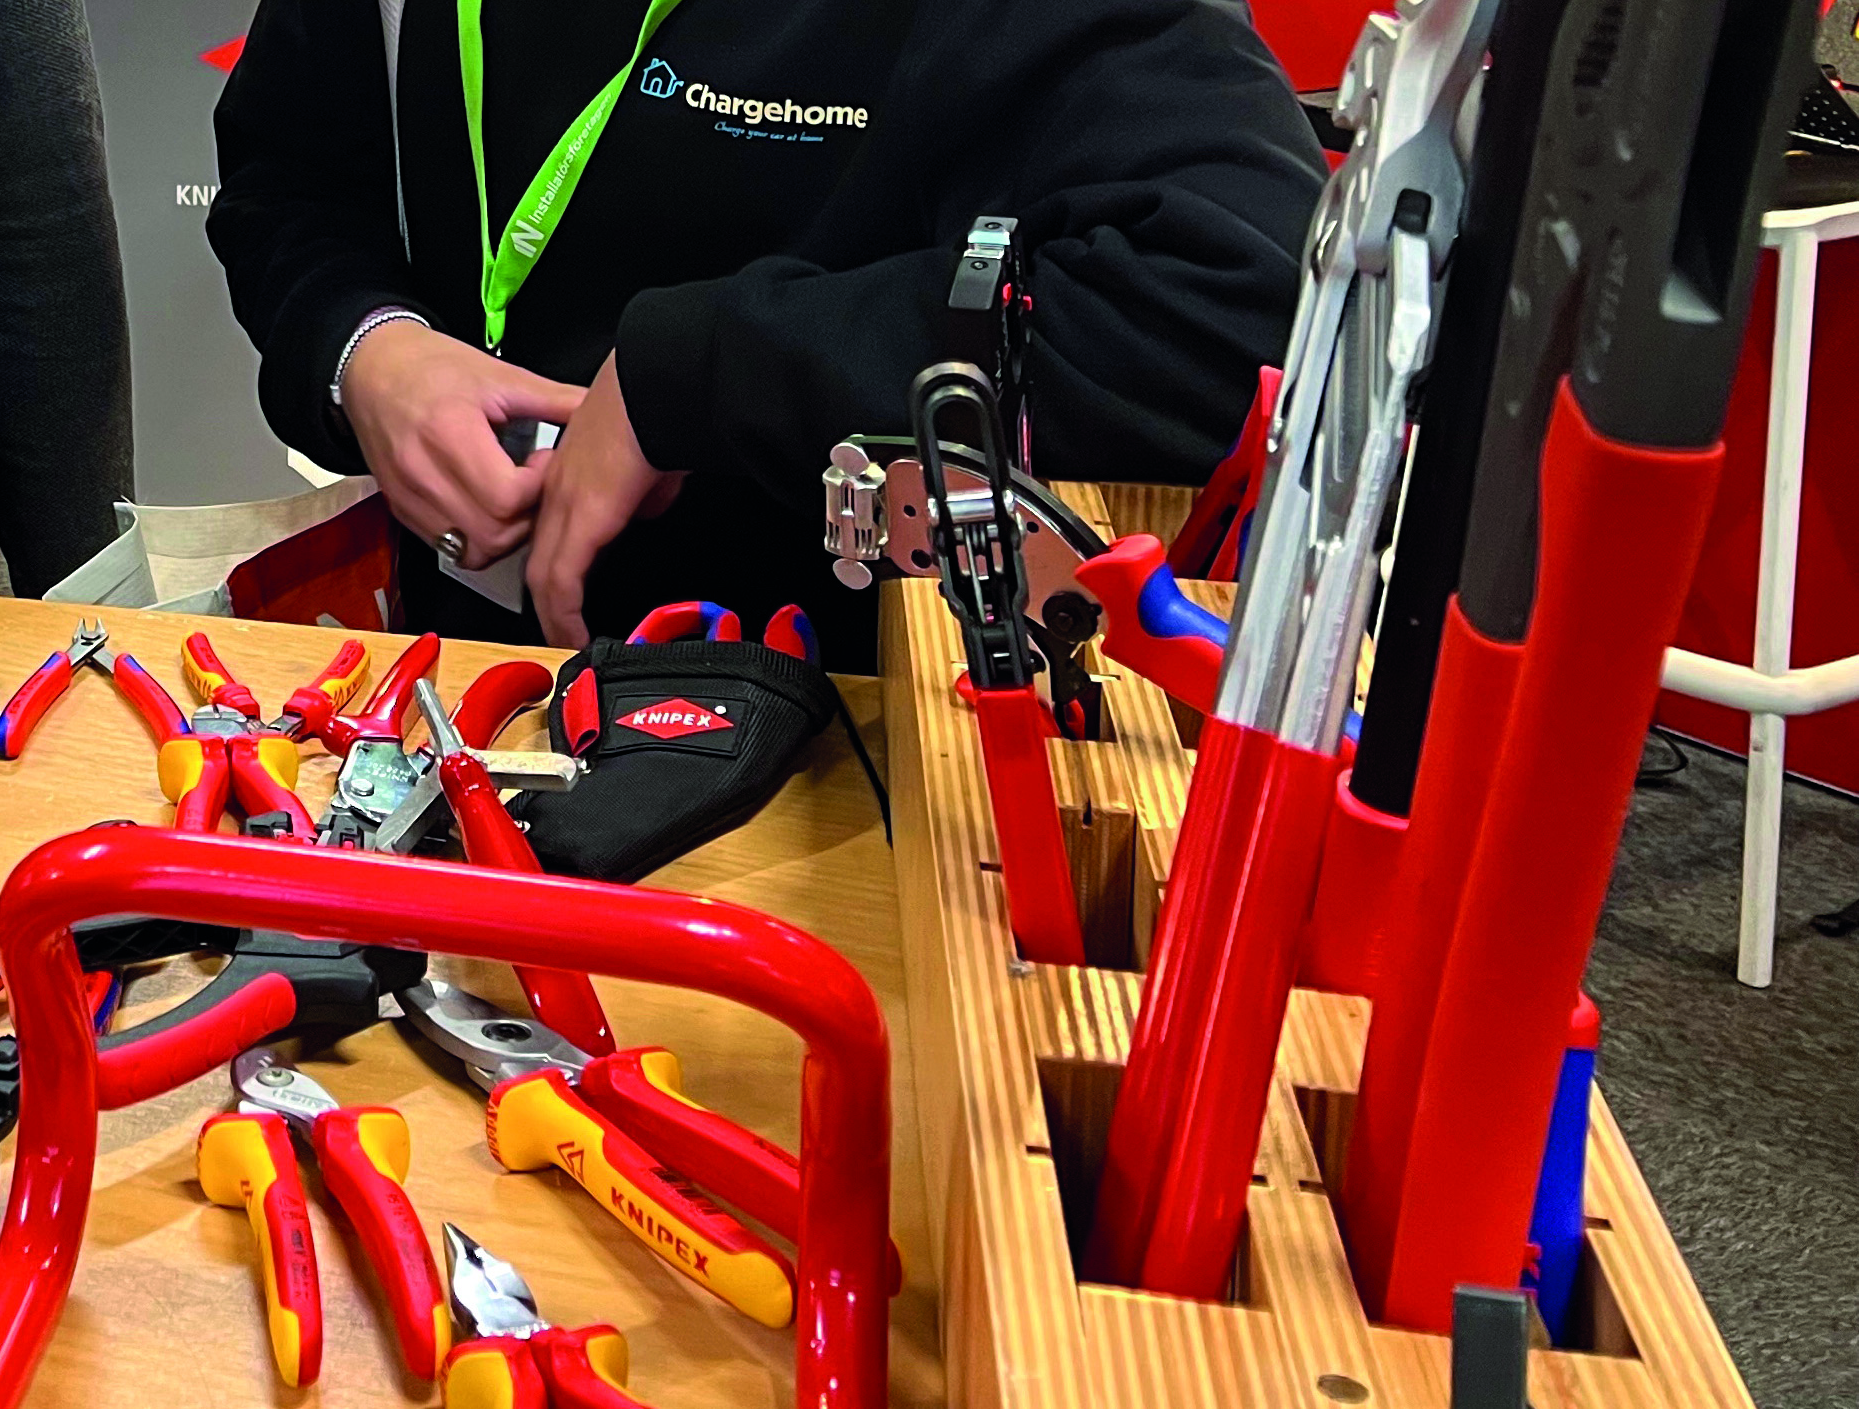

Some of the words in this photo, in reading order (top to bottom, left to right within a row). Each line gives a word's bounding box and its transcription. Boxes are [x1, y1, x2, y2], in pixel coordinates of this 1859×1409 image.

[685, 82, 869, 129] Chargehome
[176, 184, 217, 206] KNI
[632, 712, 712, 728] KNIPEX
[610, 1186, 710, 1280] KNIPEX
